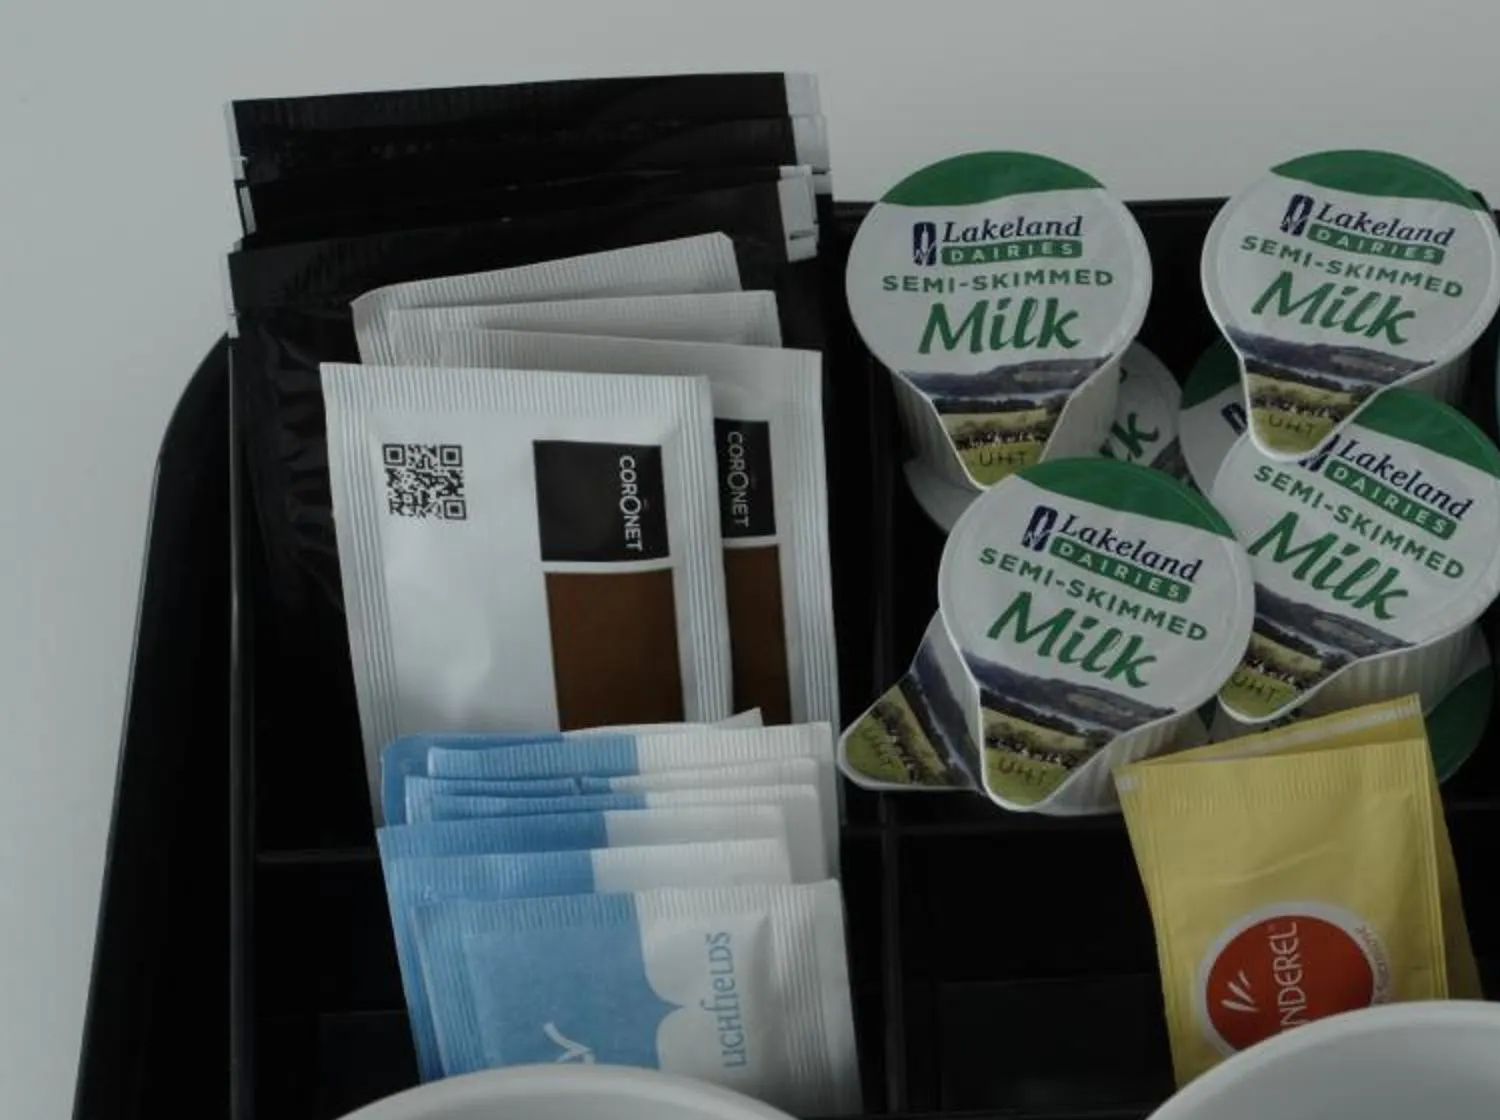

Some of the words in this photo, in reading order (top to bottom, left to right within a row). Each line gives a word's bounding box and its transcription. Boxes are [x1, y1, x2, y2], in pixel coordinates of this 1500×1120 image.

[942, 216, 1083, 243] Lakeland
[951, 243, 1074, 262] DAIRIES
[1315, 228, 1437, 262] DAIRIES
[1316, 203, 1455, 247] Lakeland
[882, 269, 1114, 293] SEMI-SKIMMED
[1241, 235, 1464, 298] SEMI-SKIMMED
[918, 297, 1081, 354] Milk
[1251, 271, 1416, 345] Milk
[1268, 414, 1316, 438] UHT
[618, 454, 644, 553] CORONET
[727, 430, 751, 529] CORONET
[1332, 467, 1445, 533] DAIRIES
[1340, 439, 1473, 520] Lakeland
[1058, 513, 1203, 583] Lakeland
[1254, 465, 1465, 580] SEMI-SKIMMED
[979, 546, 1208, 642] SEMI-SKIMMED
[1058, 544, 1182, 600] DAIRIES
[1248, 511, 1409, 621] Milk
[986, 591, 1159, 688] Milk
[998, 757, 1049, 787] UHT
[1267, 920, 1311, 1027] NDEREL
